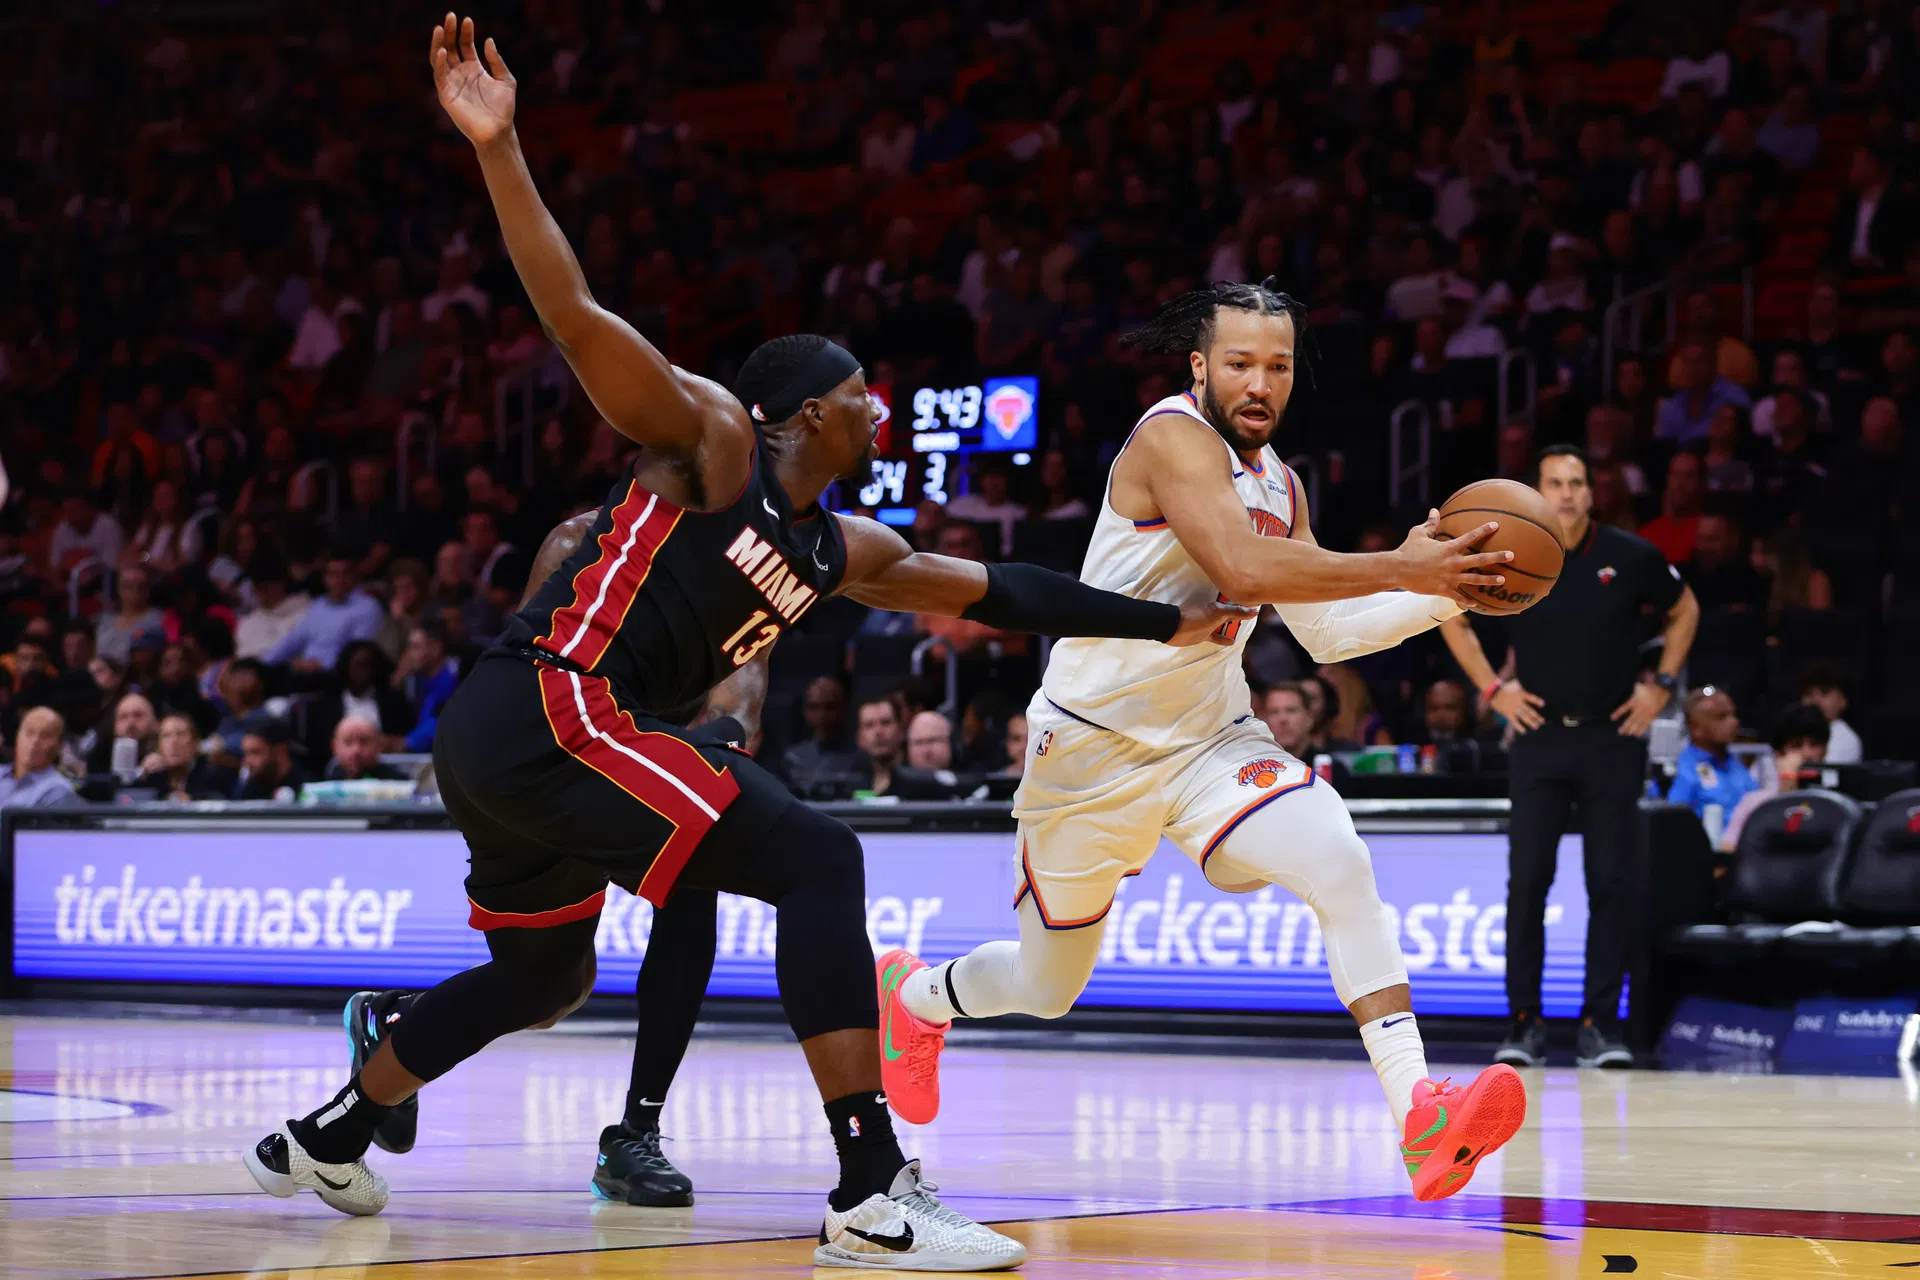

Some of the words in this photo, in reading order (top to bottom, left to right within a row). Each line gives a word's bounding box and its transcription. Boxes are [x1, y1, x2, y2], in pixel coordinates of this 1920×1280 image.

[912, 385, 982, 430] 9:43
[723, 524, 819, 626] MIAMI
[720, 608, 783, 668] 13
[54, 864, 412, 949] ticketmaster
